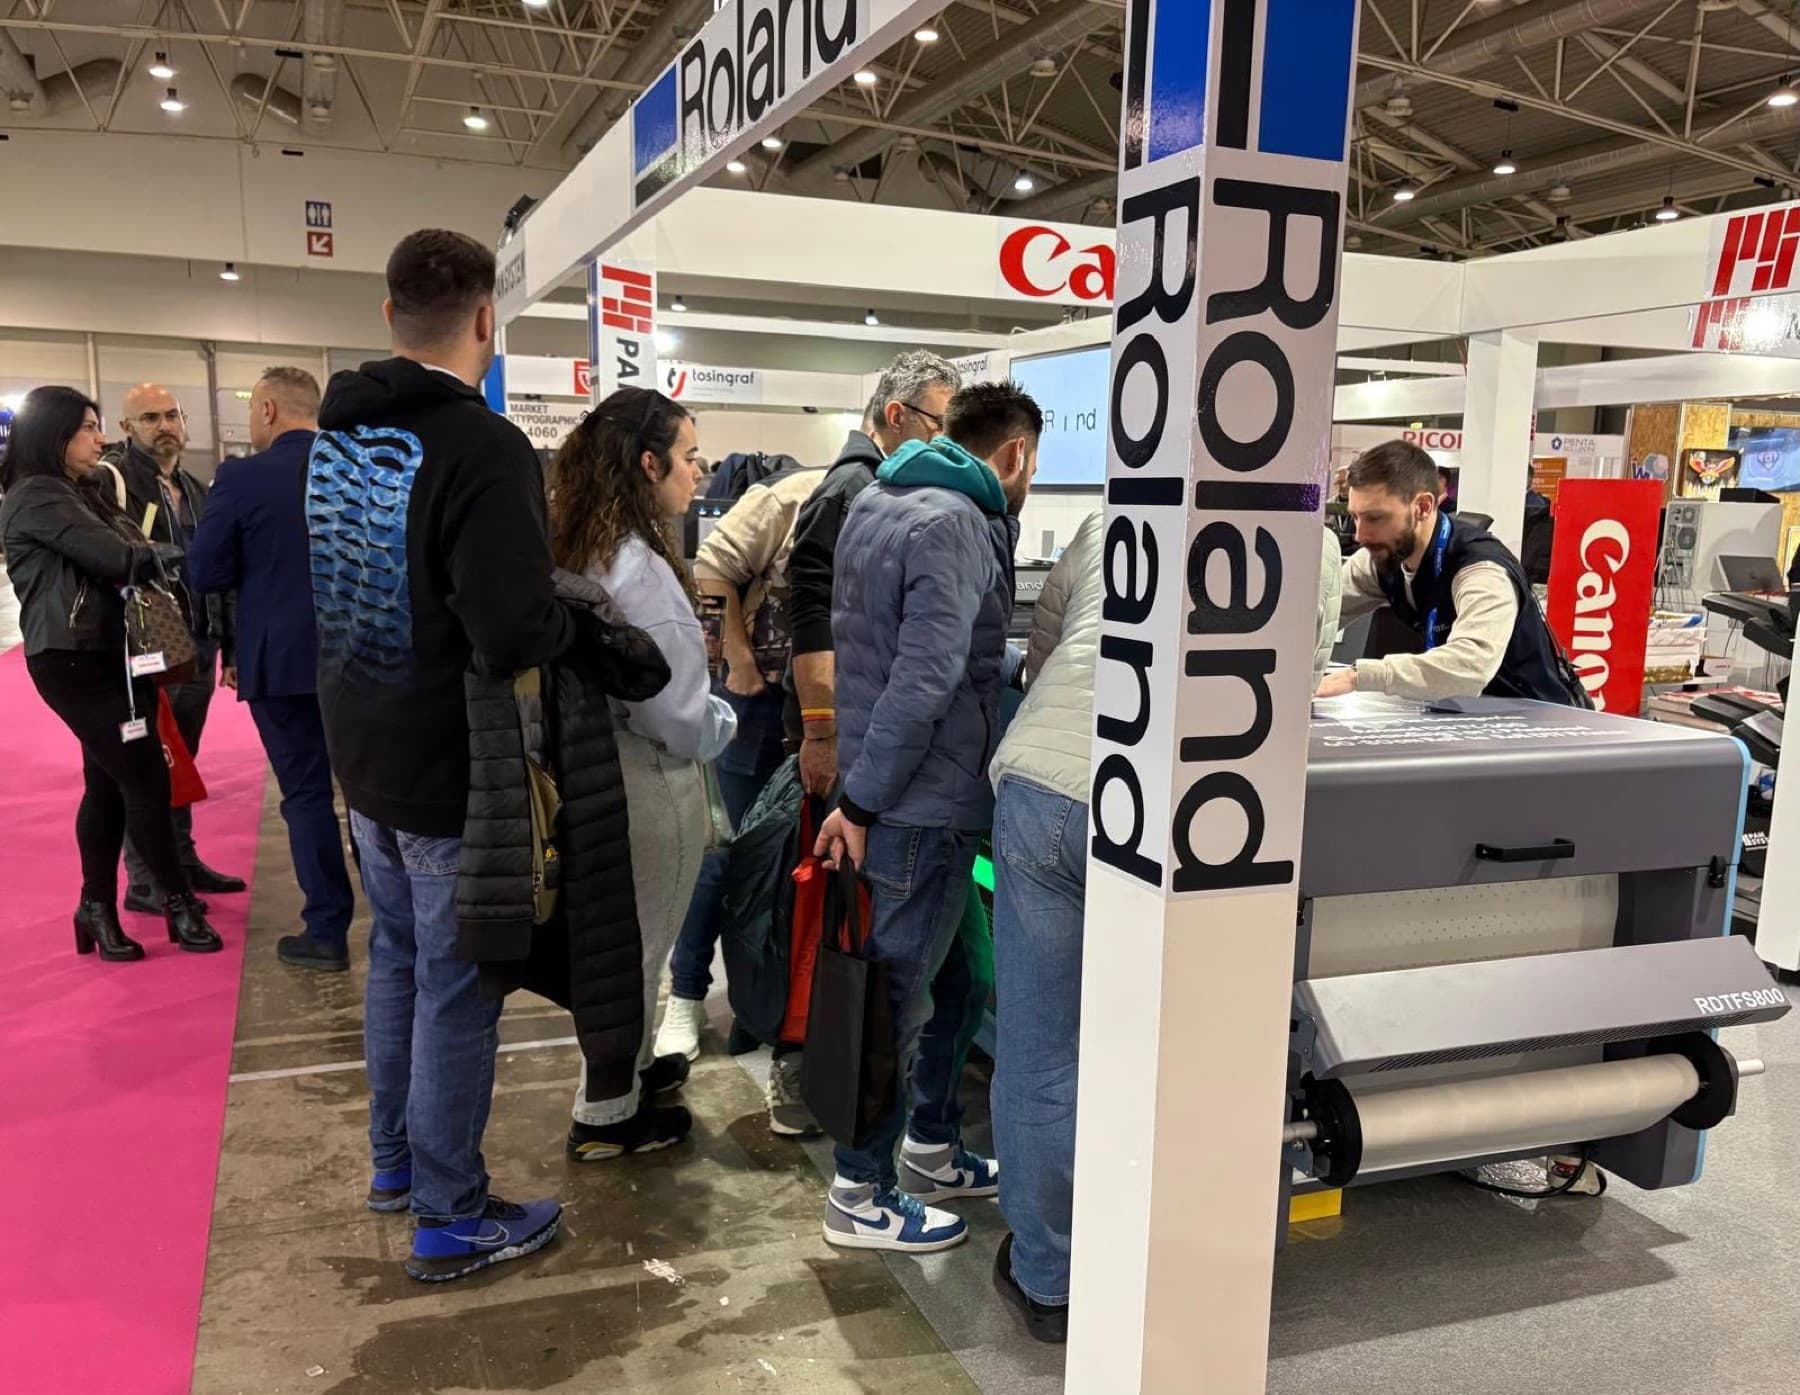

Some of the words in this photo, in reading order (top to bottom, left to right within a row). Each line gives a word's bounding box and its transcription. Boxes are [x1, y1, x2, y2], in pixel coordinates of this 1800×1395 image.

[616, 338, 640, 389] PA
[1092, 175, 1200, 889] Roland
[1172, 177, 1341, 894] Roland
[1693, 987, 1785, 1015] RDTFS800
